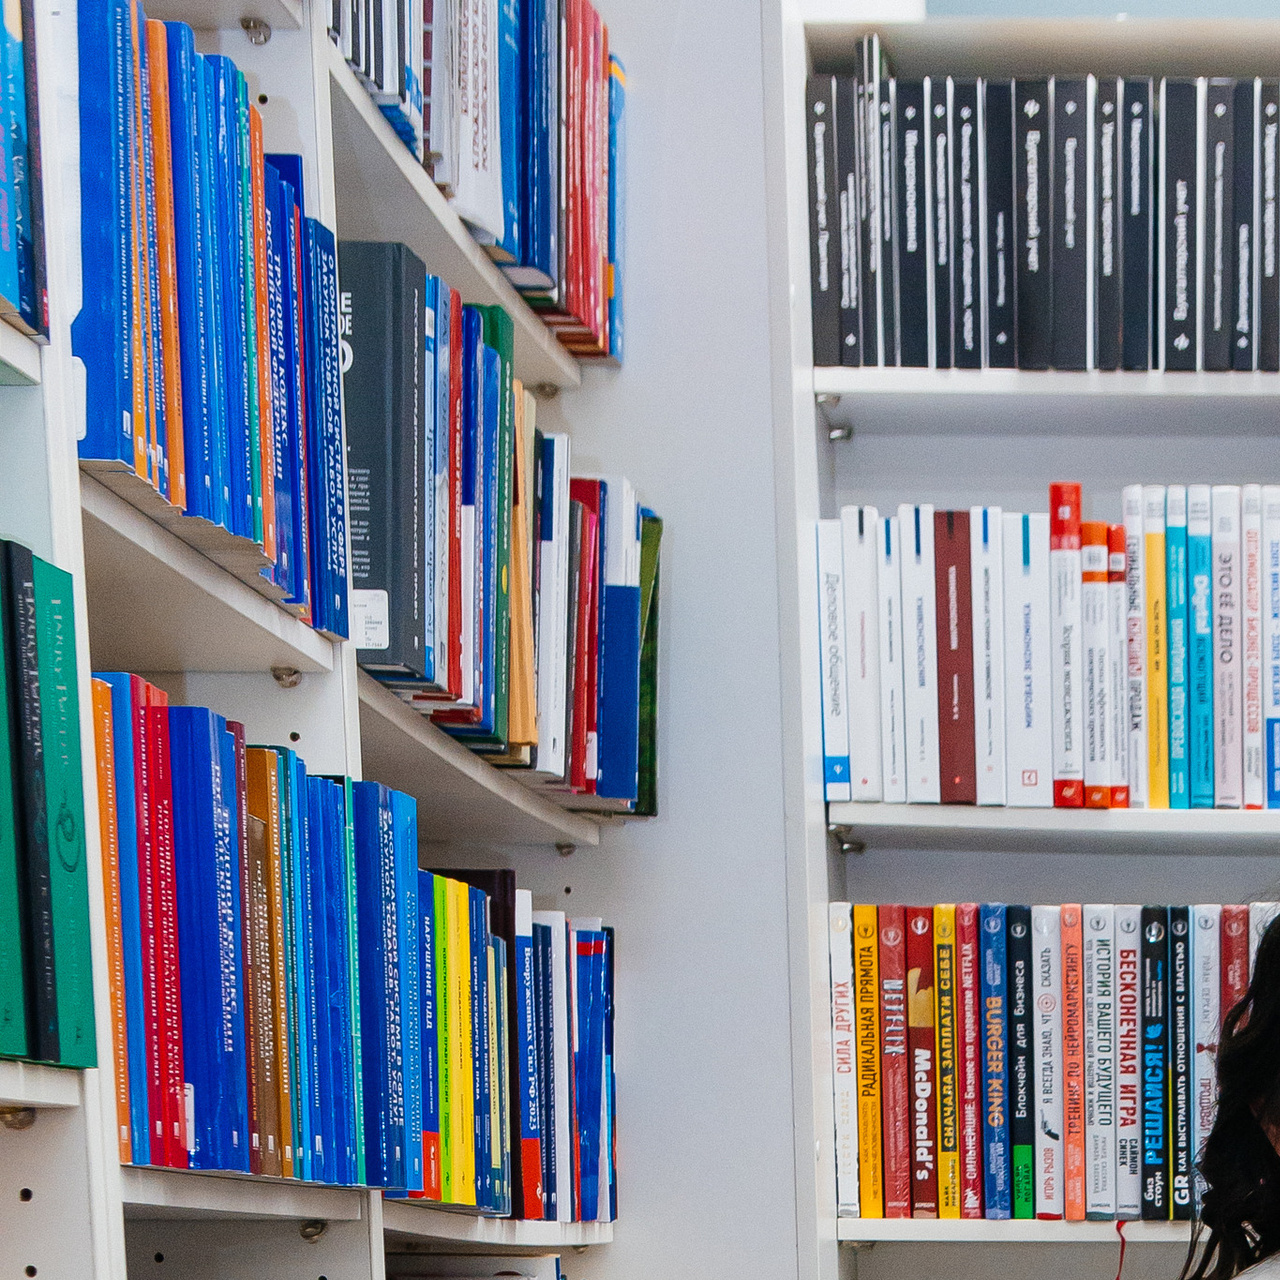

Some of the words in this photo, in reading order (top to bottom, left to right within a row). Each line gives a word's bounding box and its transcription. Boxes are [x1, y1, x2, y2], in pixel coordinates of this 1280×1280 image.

[265, 210, 279, 348] РОССИЙСКОЙ
[274, 254, 285, 361] ТРУДОВОЙ
[270, 355, 283, 480] ФЕДЕРАЦИИ
[279, 368, 289, 448] КОДЕКС
[1218, 554, 1233, 588] ЭТО
[825, 573, 840, 641] Деловое
[1219, 594, 1236, 608] ЕЁ
[1218, 615, 1233, 664] ДЕЛО
[826, 645, 843, 717] общение
[423, 916, 433, 997] НАРУШЕНИЕ
[859, 946, 874, 1002] ПРЯМОТА
[940, 949, 951, 988] СЕБЕ
[1097, 938, 1112, 996] ИСТОРИЯ
[1176, 942, 1185, 992] ВЛАСТЬЮ
[425, 1001, 434, 1030] ПДД
[522, 947, 536, 1042] Вооруженных
[834, 981, 851, 1032] ДРУГИХ
[1014, 961, 1025, 1016] бизнеса
[1064, 942, 1079, 1056] НЕЙРОМАРКЕТИНГУ
[1119, 949, 1137, 1075] БЕСКОНЕЧНАЯ
[883, 979, 904, 1055] NETFLIX
[941, 996, 953, 1069] ЗАПЛАТИ
[985, 996, 1003, 1074] BURGER
[1016, 1023, 1026, 1048] для
[1097, 1004, 1112, 1052] ВАШЕГО
[1176, 1006, 1186, 1072] ОТНОШЕНИЯ
[525, 1045, 536, 1074] Сил
[838, 1040, 850, 1073] СИЛА
[860, 1007, 876, 1097] РАДИКАЛЬНАЯ
[1067, 1062, 1079, 1077] ПО
[526, 1077, 537, 1098] РФ
[942, 1076, 955, 1147] СНАЧАЛА
[987, 1079, 1004, 1127] KING
[1015, 1056, 1027, 1118] Блокчейн
[1068, 1082, 1080, 1135] ТРЕНИНГ
[1095, 1059, 1112, 1126] БУДУЩЕГО
[1119, 1084, 1137, 1127] ИГРА
[1145, 1045, 1164, 1165] РЕШАЙСЯ!
[1177, 1075, 1187, 1147] ВЫСТРАИВАТЬ
[527, 1101, 538, 1131] 2023
[1119, 1139, 1127, 1166] СИНЕК
[1128, 1138, 1139, 1175] САЙМОН
[1177, 1151, 1187, 1172] КАК
[1175, 1175, 1190, 1205] GR
